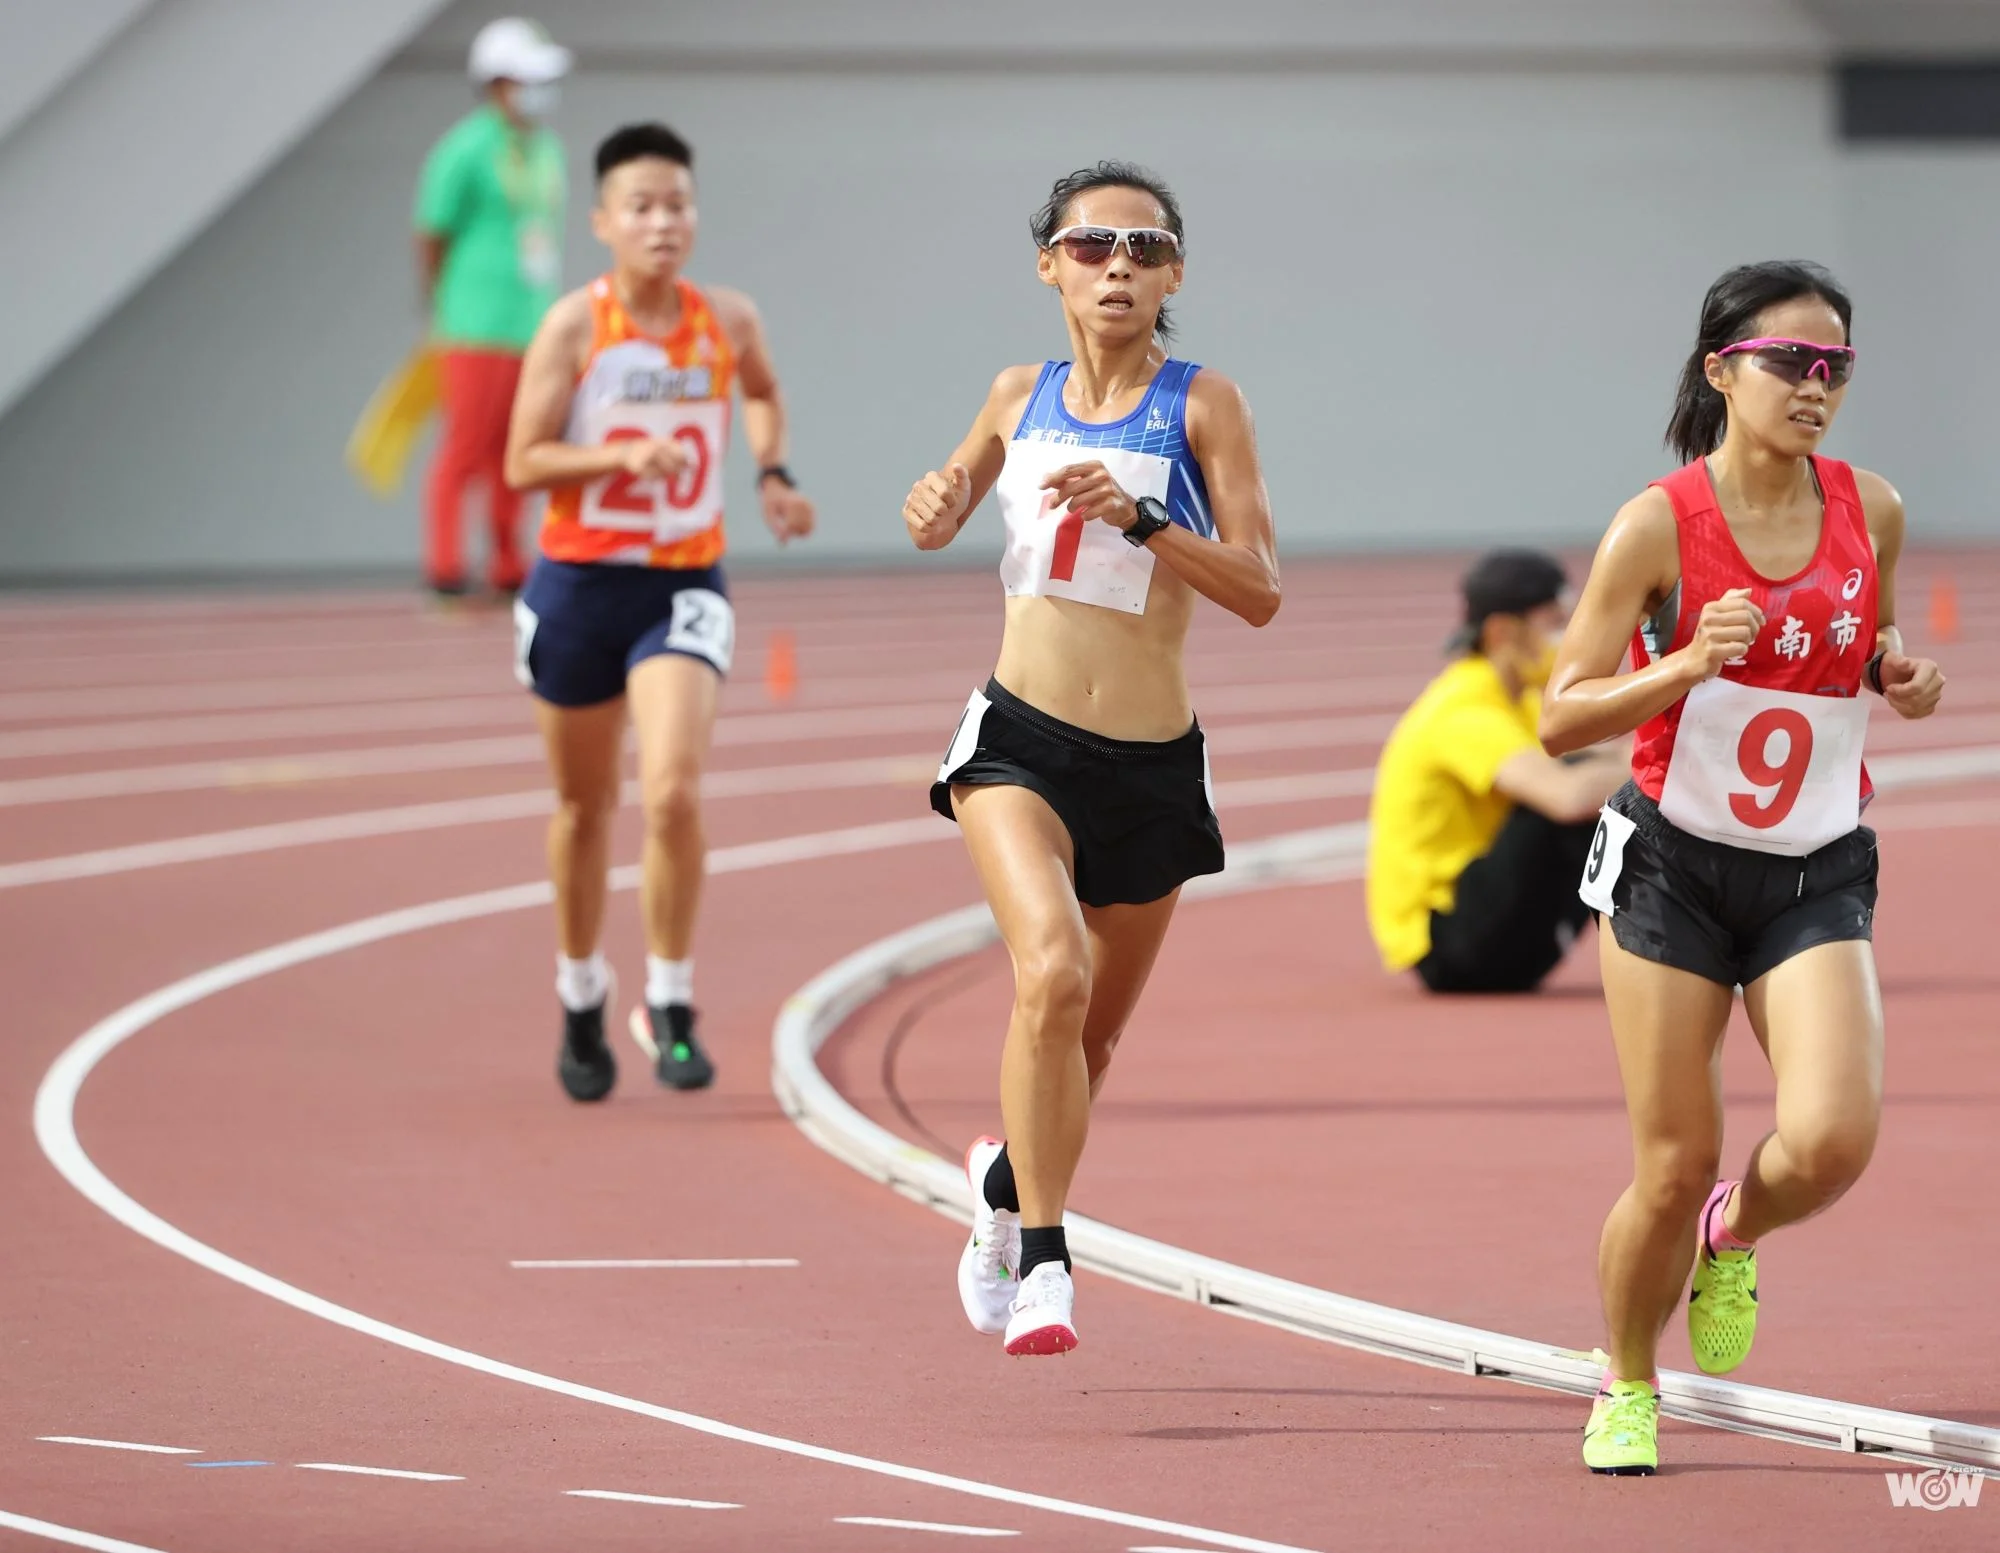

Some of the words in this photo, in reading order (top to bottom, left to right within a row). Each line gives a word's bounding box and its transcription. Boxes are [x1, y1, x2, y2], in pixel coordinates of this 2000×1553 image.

[599, 425, 708, 512] 20
[1728, 707, 1813, 829] 9
[1588, 820, 1608, 884] 9
